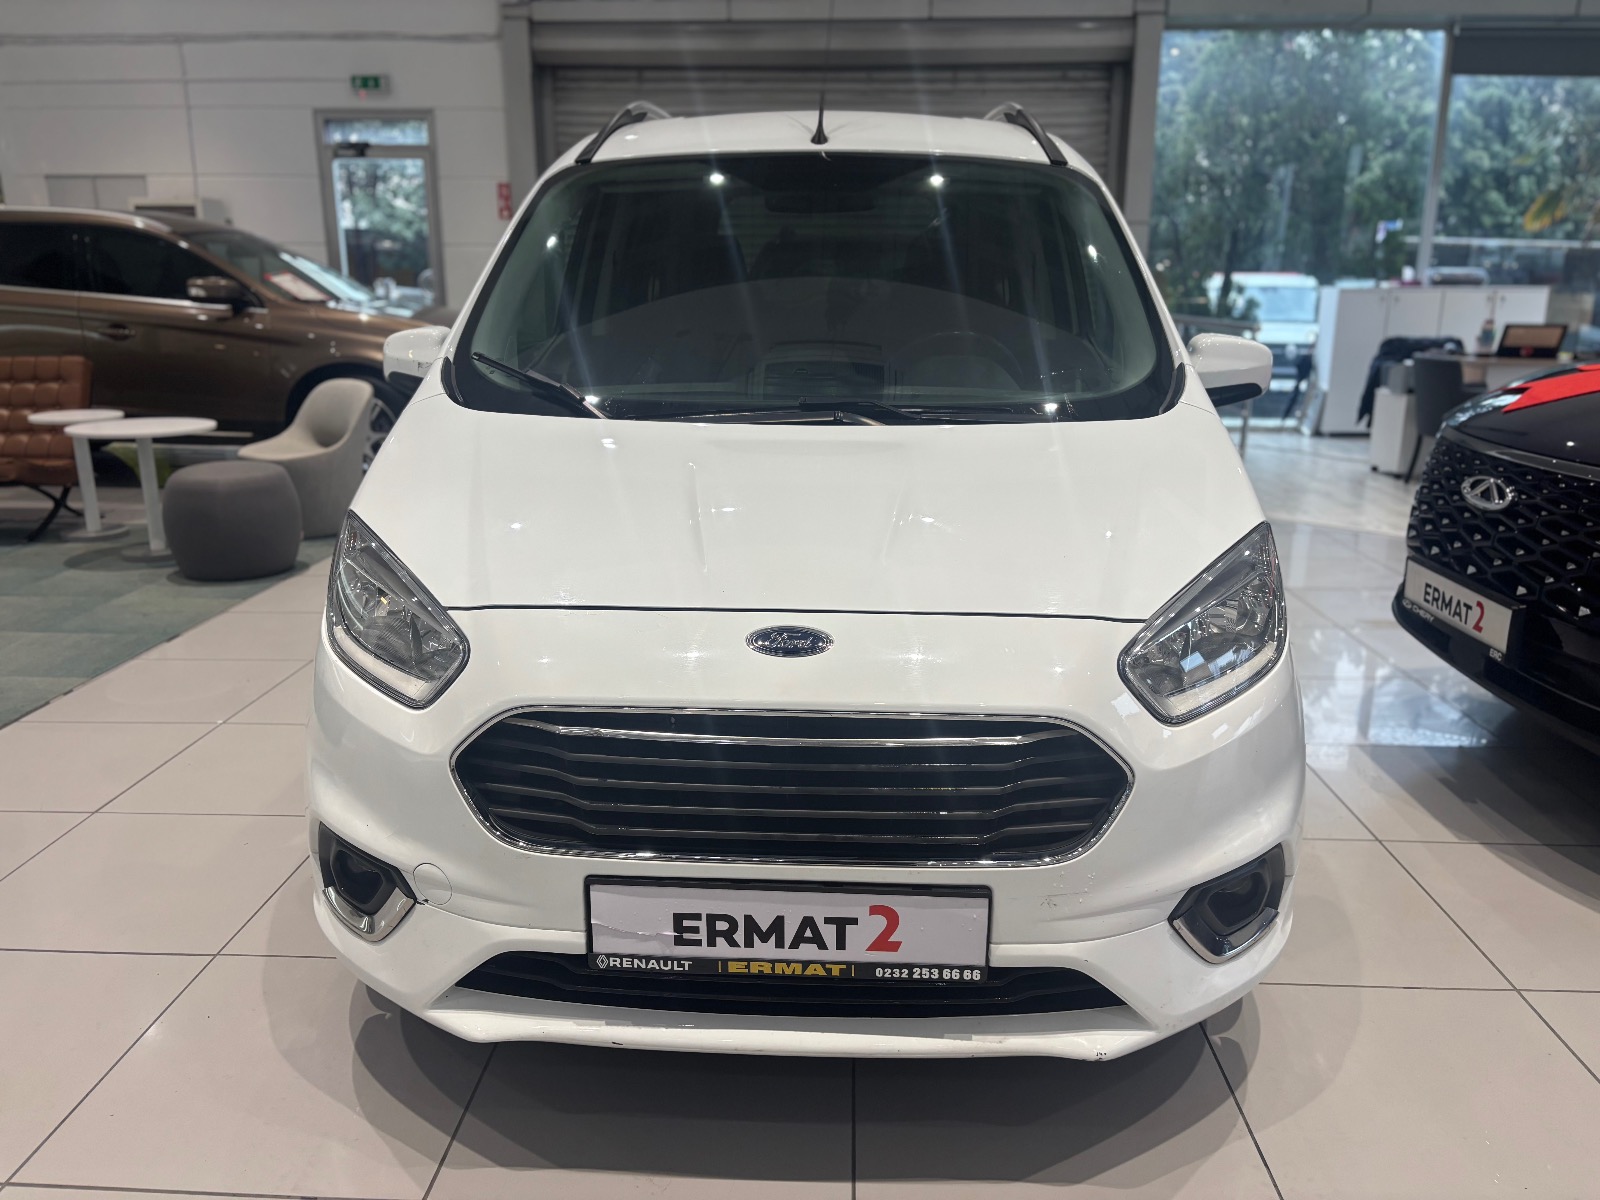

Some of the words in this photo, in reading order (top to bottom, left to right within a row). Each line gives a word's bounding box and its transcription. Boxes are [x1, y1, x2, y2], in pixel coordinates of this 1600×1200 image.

[1423, 582, 1473, 625] ERMAT
[1472, 600, 1485, 634] 2
[768, 631, 814, 649] Ford
[672, 912, 859, 951] ERMAT
[865, 904, 903, 953] 2
[609, 956, 693, 972] RENAULT
[727, 961, 847, 977] ERMAT
[875, 967, 909, 978] 0232
[912, 967, 939, 979] 253
[942, 968, 961, 980] 66
[963, 969, 981, 981] 66
